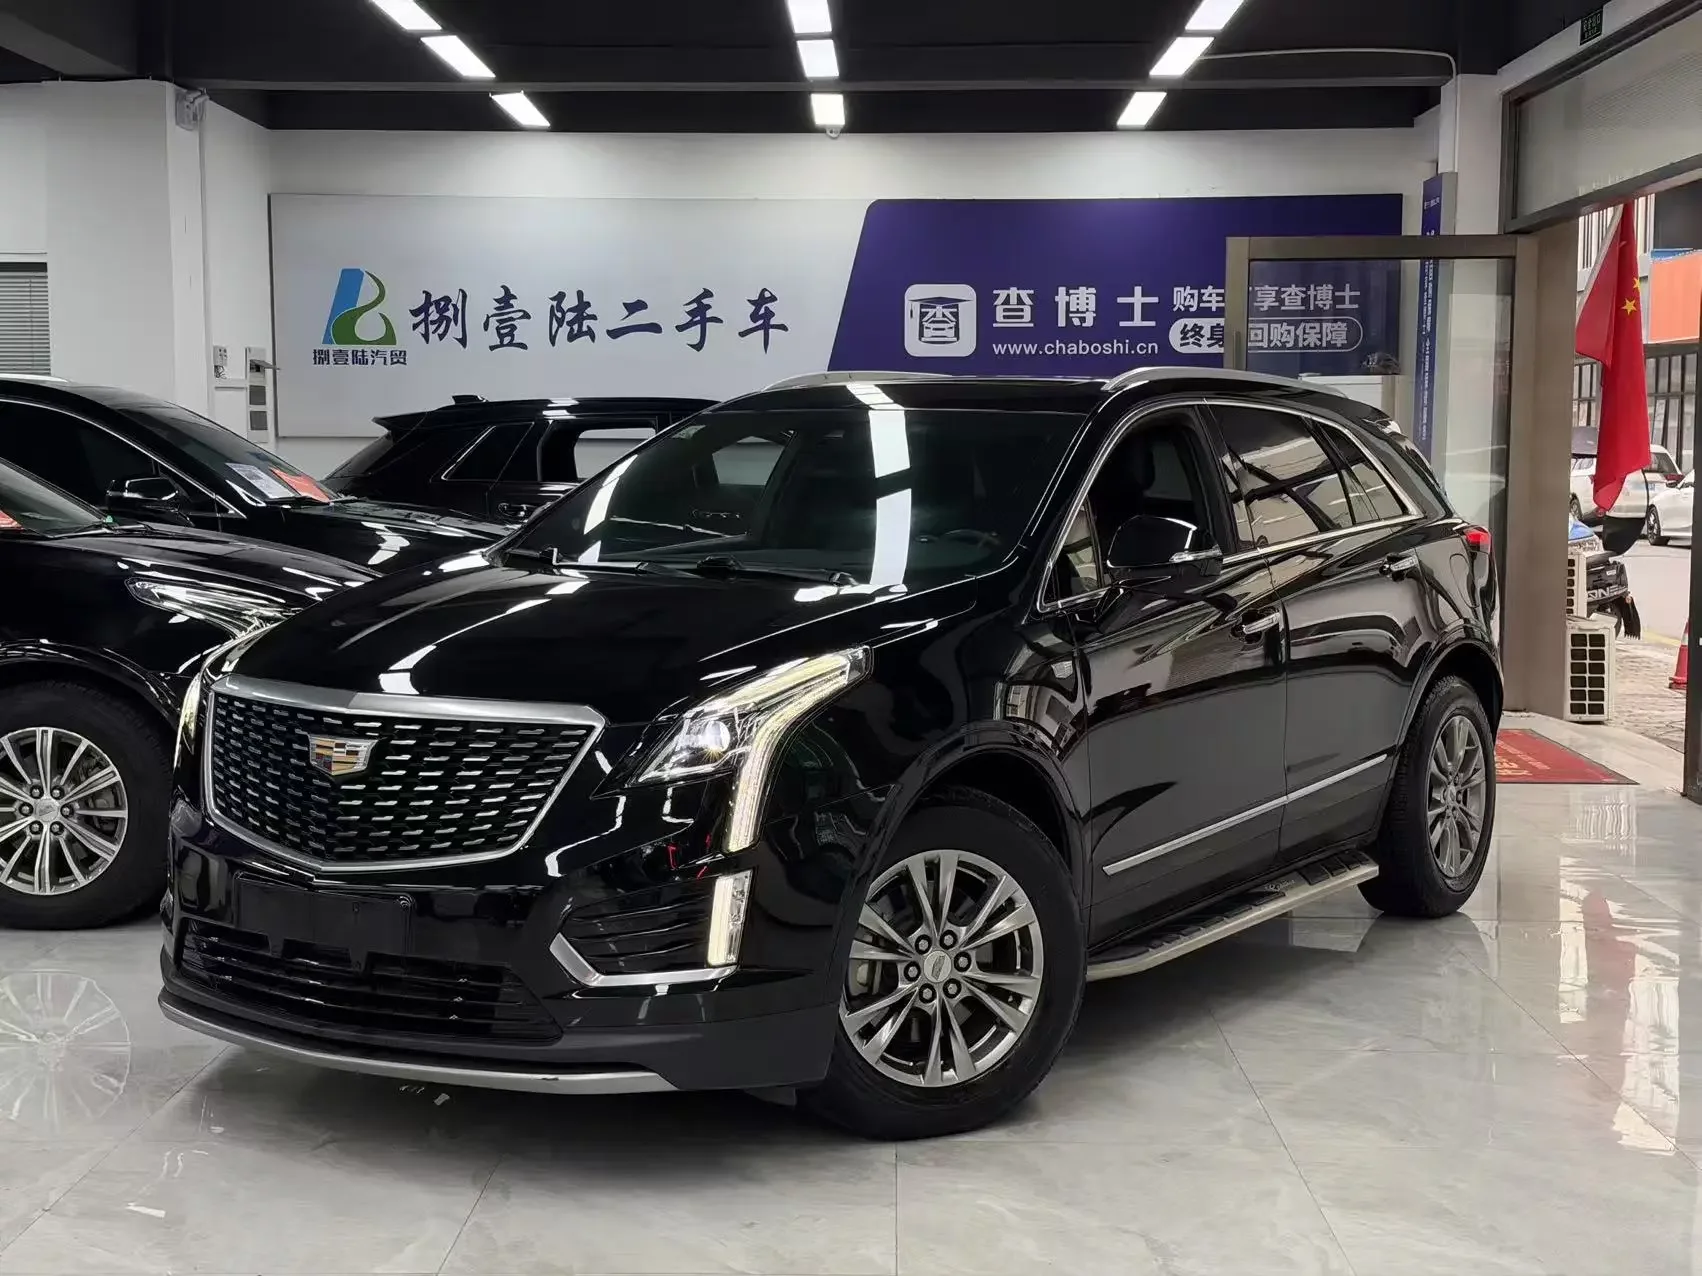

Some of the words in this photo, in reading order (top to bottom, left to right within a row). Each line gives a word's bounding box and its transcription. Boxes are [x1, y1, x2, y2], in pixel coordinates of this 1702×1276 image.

[993, 286, 1160, 327] 查博士
[1173, 284, 1361, 312] 购车享查博士
[408, 284, 790, 354] 捌壹陆二手车
[312, 348, 408, 366] 捌壹陆汽贸
[992, 339, 1159, 356] www.chaboshi.cn
